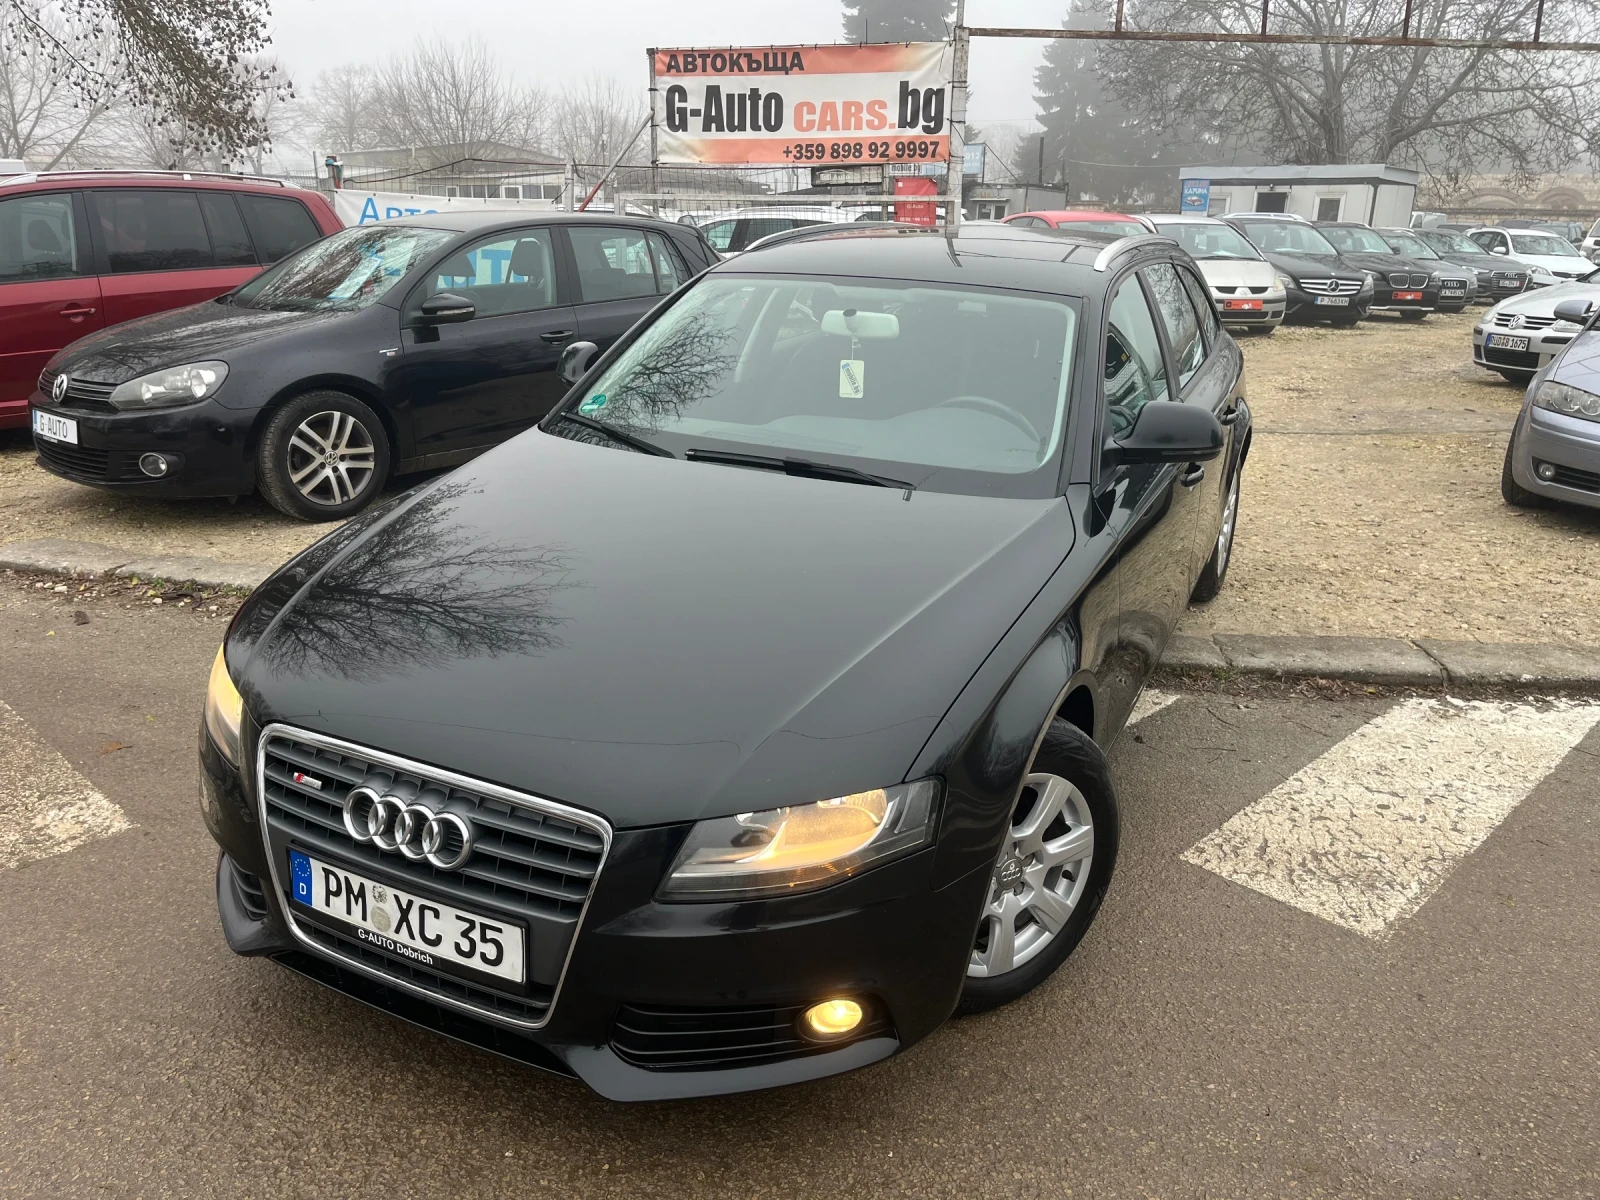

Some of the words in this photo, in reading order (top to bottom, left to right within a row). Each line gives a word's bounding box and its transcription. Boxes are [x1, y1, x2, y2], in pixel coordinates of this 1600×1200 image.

[666, 51, 805, 75] АВТОКЪЩА
[665, 84, 784, 133] G-Auto
[783, 143, 826, 160] +359
[830, 142, 864, 159] 898
[868, 142, 890, 159] 92
[895, 140, 940, 158] 9997
[1510, 338, 1527, 350] 1675
[40, 414, 68, 439] G-AUTO
[299, 882, 307, 895] D
[321, 866, 368, 922] PM
[393, 893, 443, 947] XC
[454, 913, 504, 967] 35
[358, 929, 395, 950] G-AUTO
[396, 942, 433, 965] Dobrich
